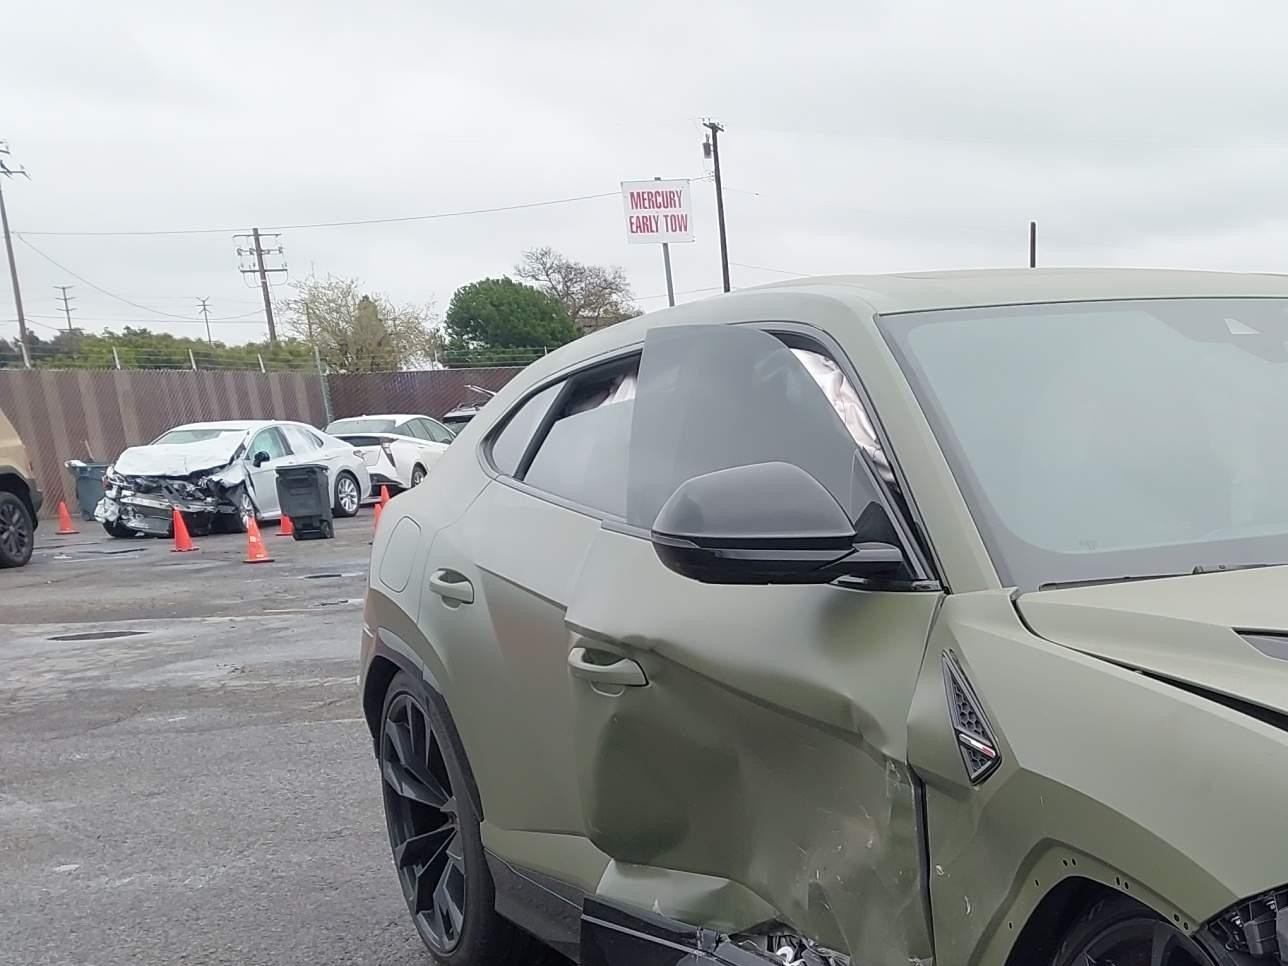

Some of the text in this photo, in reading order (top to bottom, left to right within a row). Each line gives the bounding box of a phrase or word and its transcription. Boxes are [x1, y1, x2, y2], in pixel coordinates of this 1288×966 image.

[629, 190, 683, 210] MERCURY
[629, 214, 688, 233] EARLY TOW
